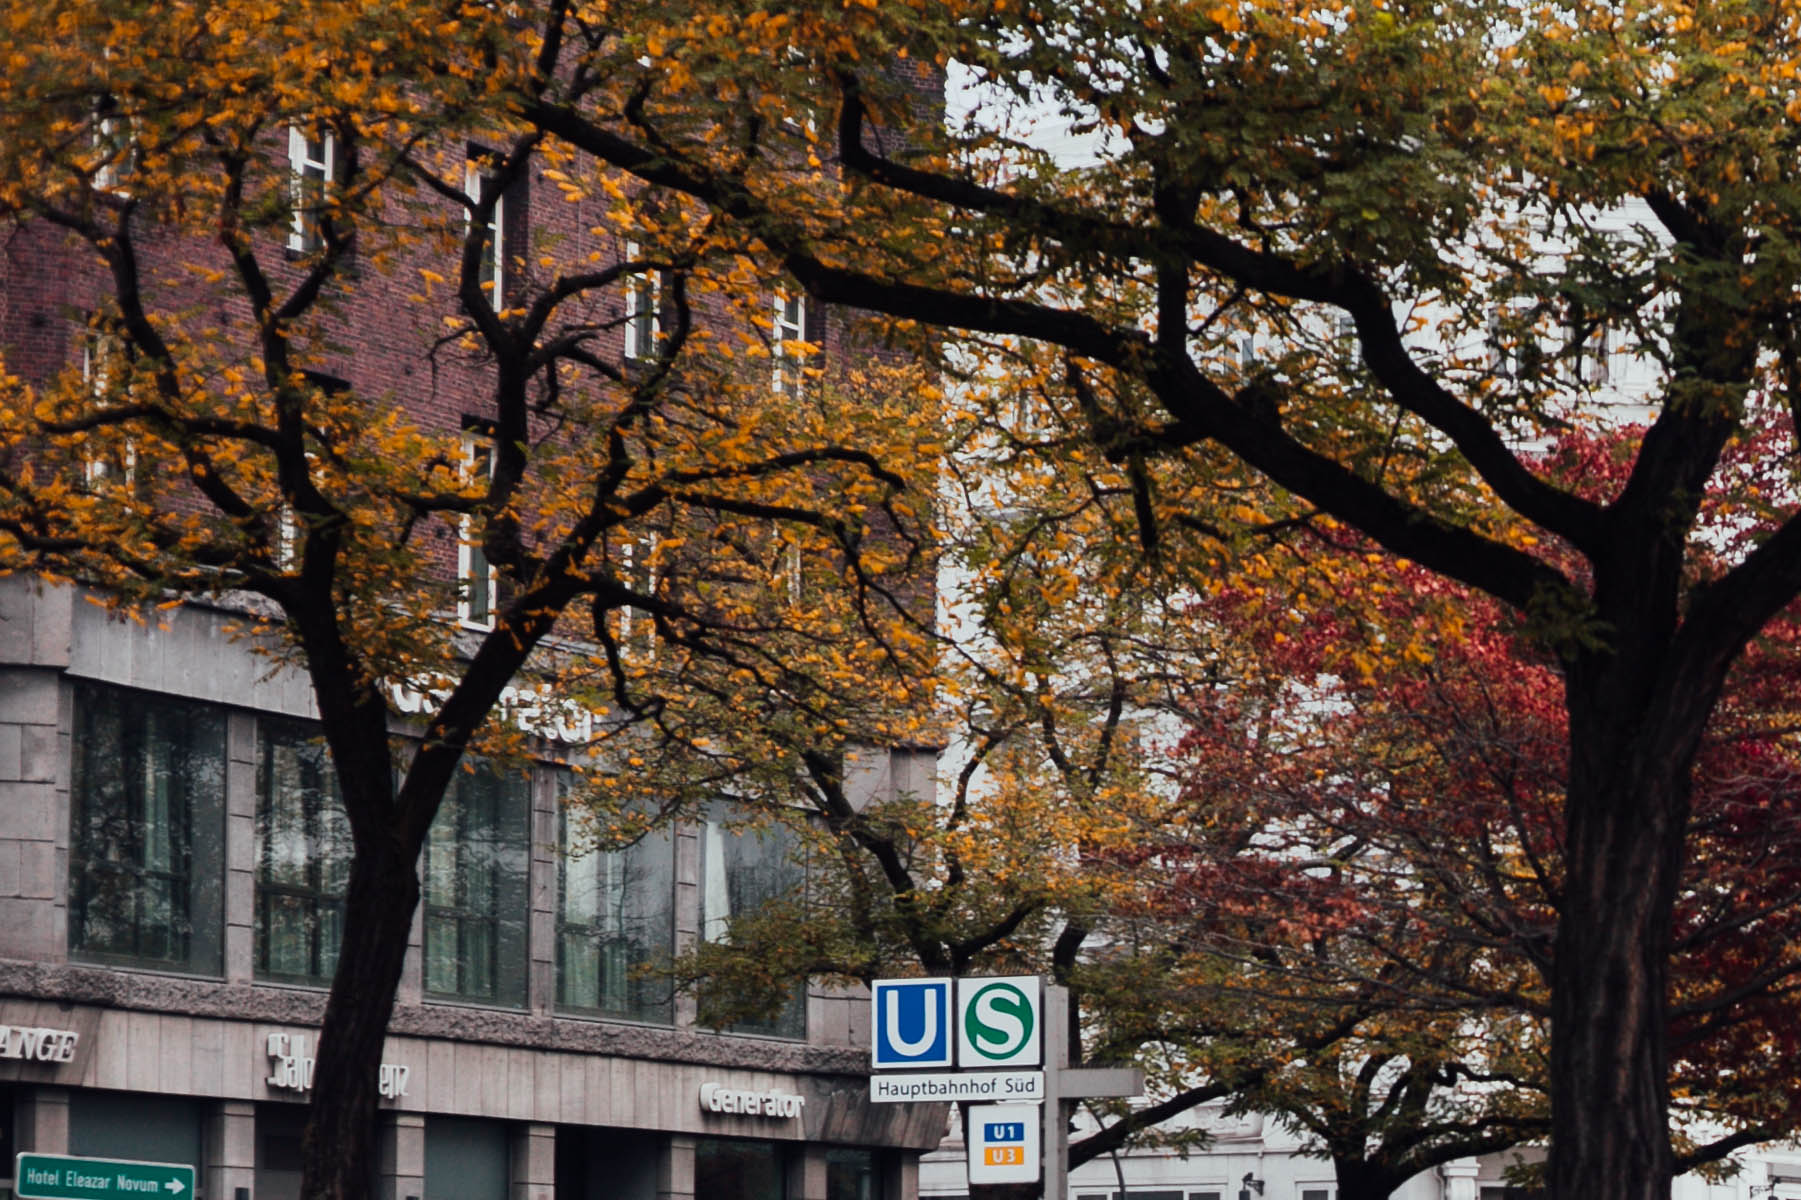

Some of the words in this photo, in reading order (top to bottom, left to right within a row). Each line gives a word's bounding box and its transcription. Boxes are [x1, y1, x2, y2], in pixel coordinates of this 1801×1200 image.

[886, 988, 937, 1057] U
[975, 988, 1025, 1055] S
[700, 1083, 805, 1118] Generator
[878, 1077, 998, 1099] Hauptbahnhof
[1005, 1077, 1035, 1094] Süd
[27, 1168, 60, 1186] Hotel
[66, 1171, 111, 1190] Eleazar
[117, 1175, 159, 1192] Novum
